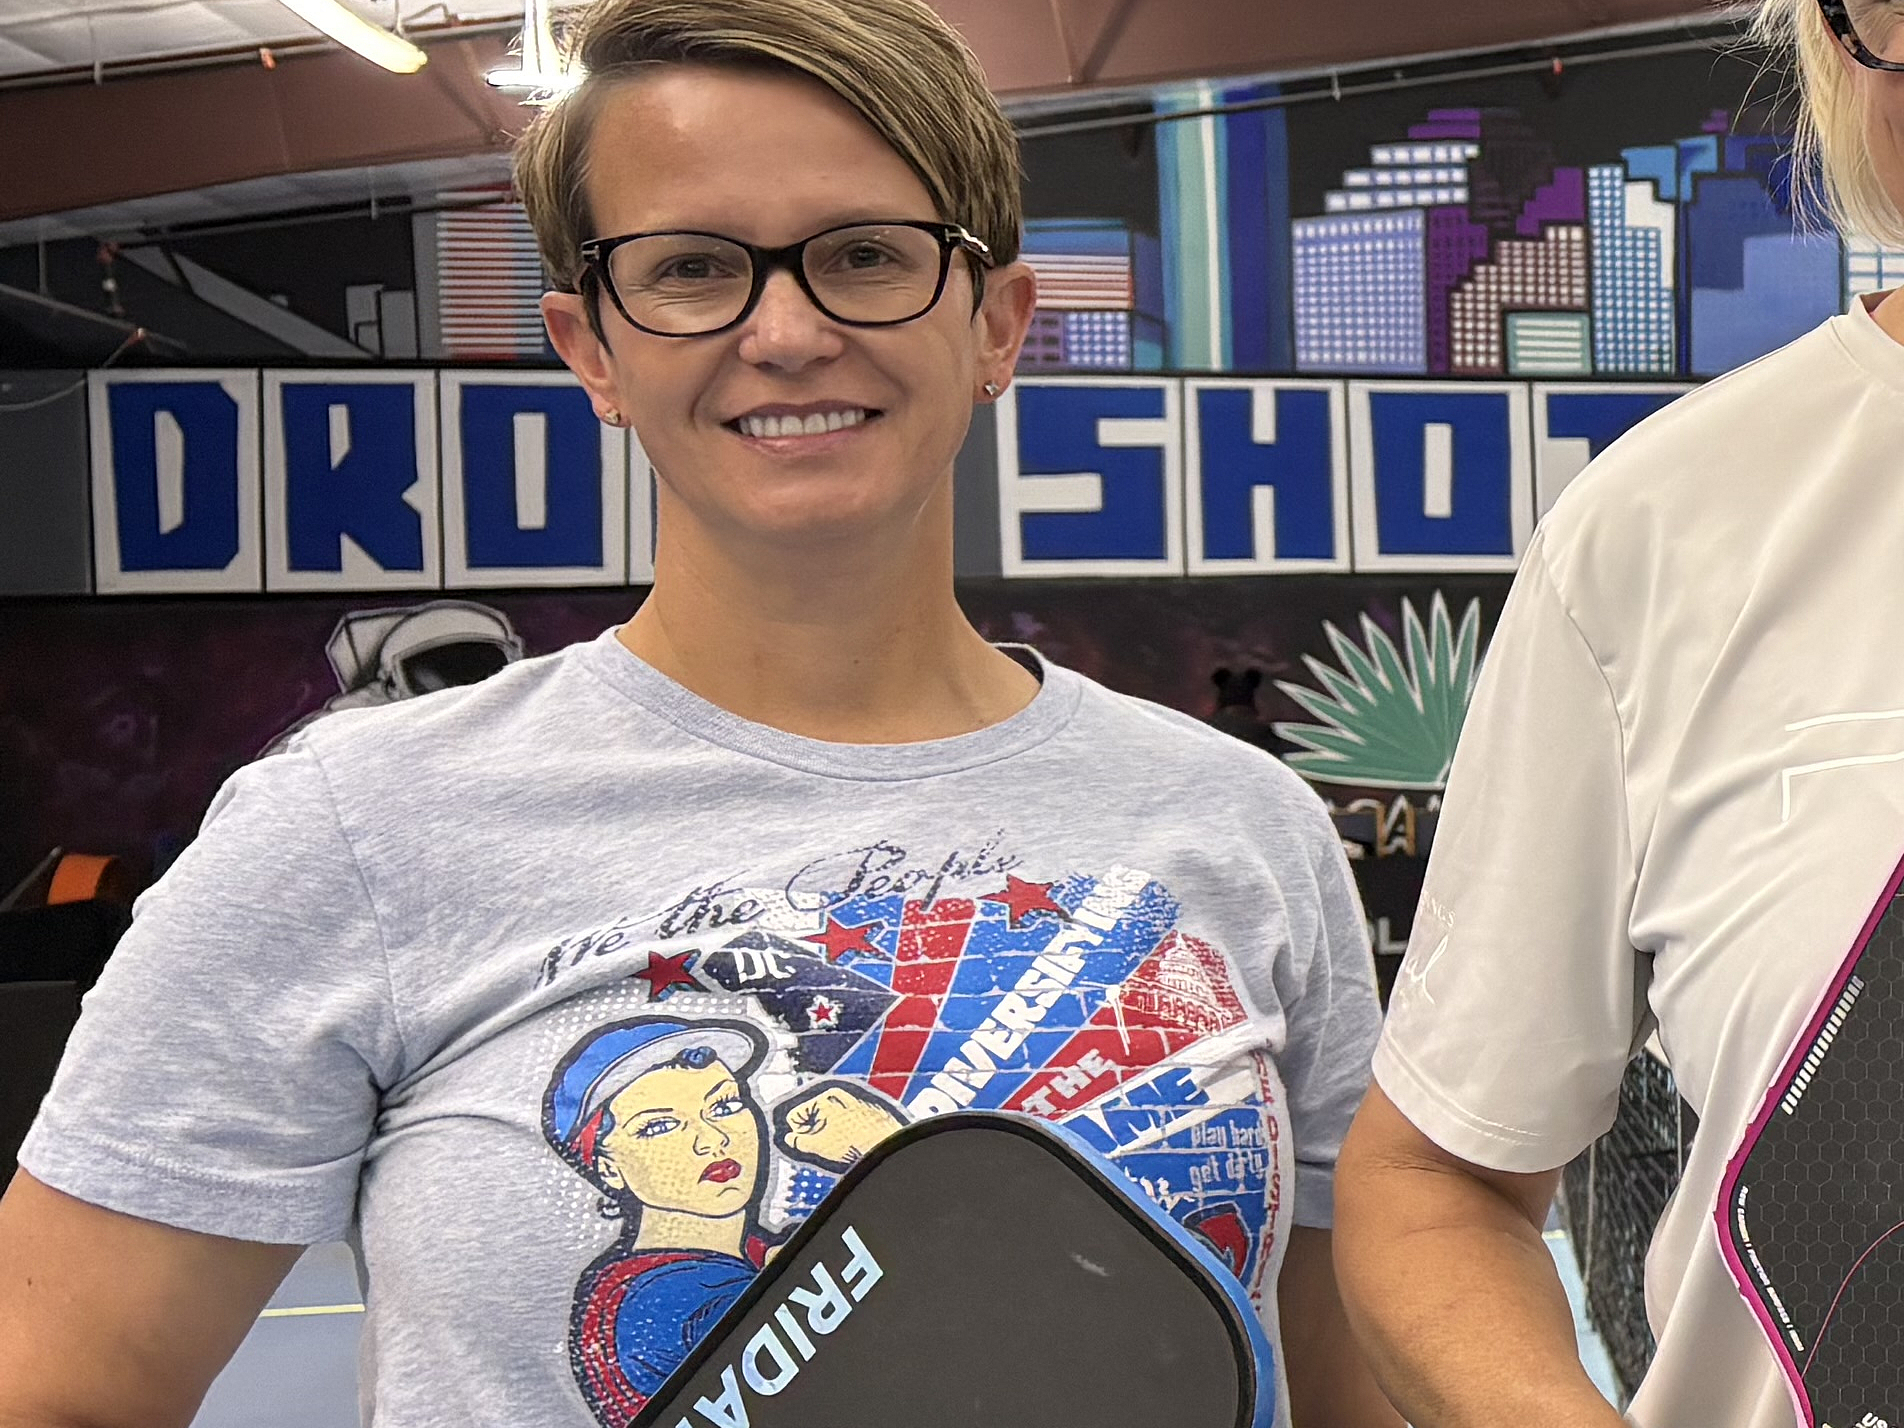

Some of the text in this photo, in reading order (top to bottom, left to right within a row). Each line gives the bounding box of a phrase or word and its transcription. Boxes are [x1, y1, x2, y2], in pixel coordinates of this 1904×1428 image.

[106, 381, 657, 572] DRO
[786, 827, 1025, 912] People
[734, 947, 799, 983] DC
[904, 922, 1106, 1121] DIVERSITY
[1020, 1047, 1112, 1115] THE
